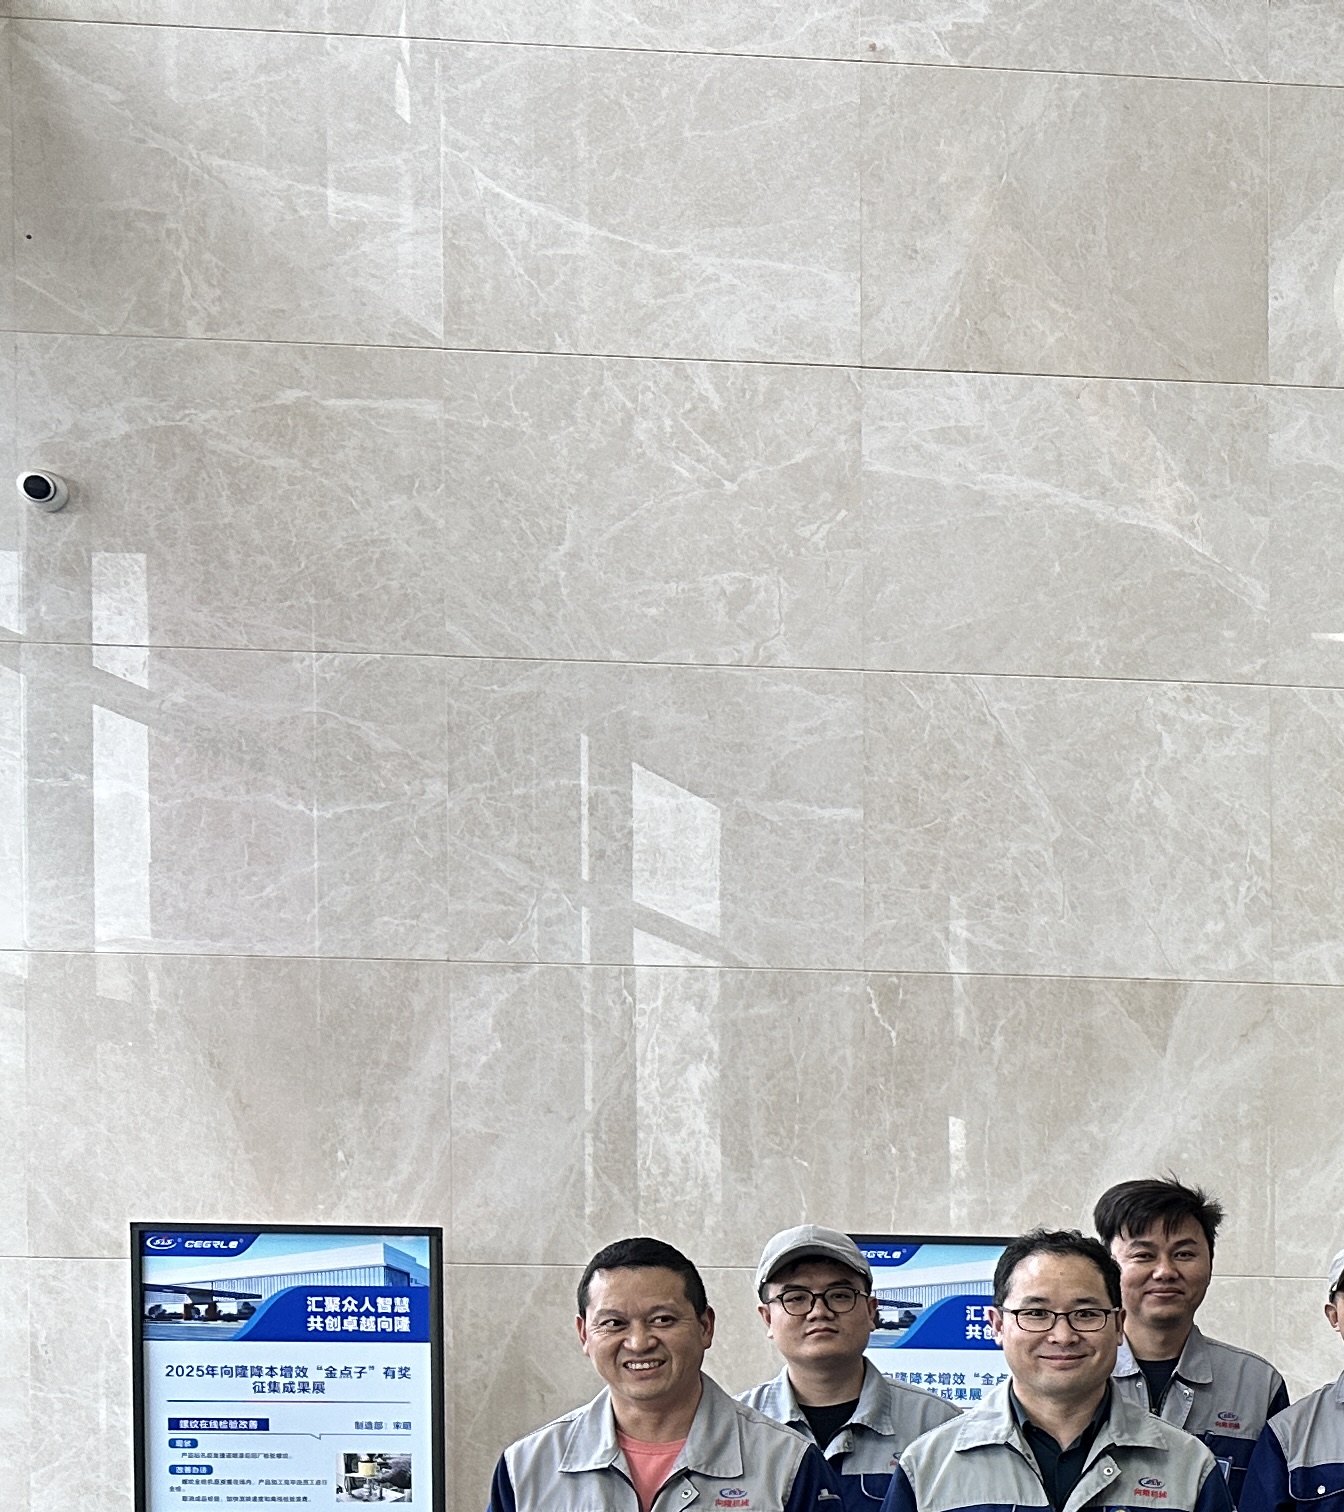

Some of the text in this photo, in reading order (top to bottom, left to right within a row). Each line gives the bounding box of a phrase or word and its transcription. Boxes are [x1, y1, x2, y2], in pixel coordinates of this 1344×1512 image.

[306, 1296, 411, 1314] 汇聚众人智慧
[306, 1315, 411, 1333] 共创卓越向隆
[252, 1381, 326, 1395] 征集成果展
